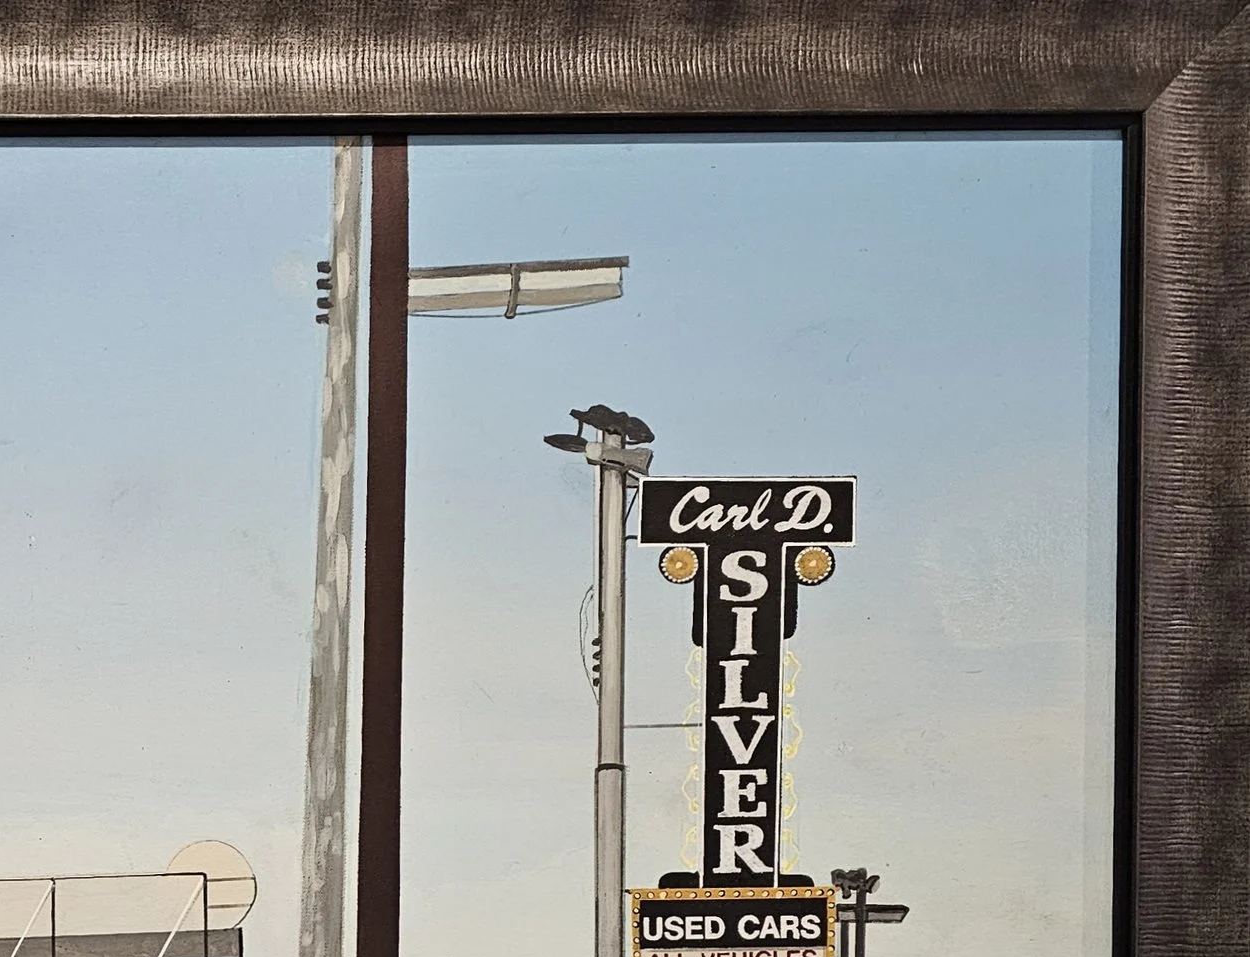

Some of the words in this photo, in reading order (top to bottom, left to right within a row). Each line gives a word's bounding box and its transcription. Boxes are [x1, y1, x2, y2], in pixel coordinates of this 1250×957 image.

[669, 486, 771, 533] Carl
[774, 485, 833, 533] D.
[711, 550, 775, 874] SILVER
[643, 916, 726, 941] USED
[738, 915, 821, 940] CARS
